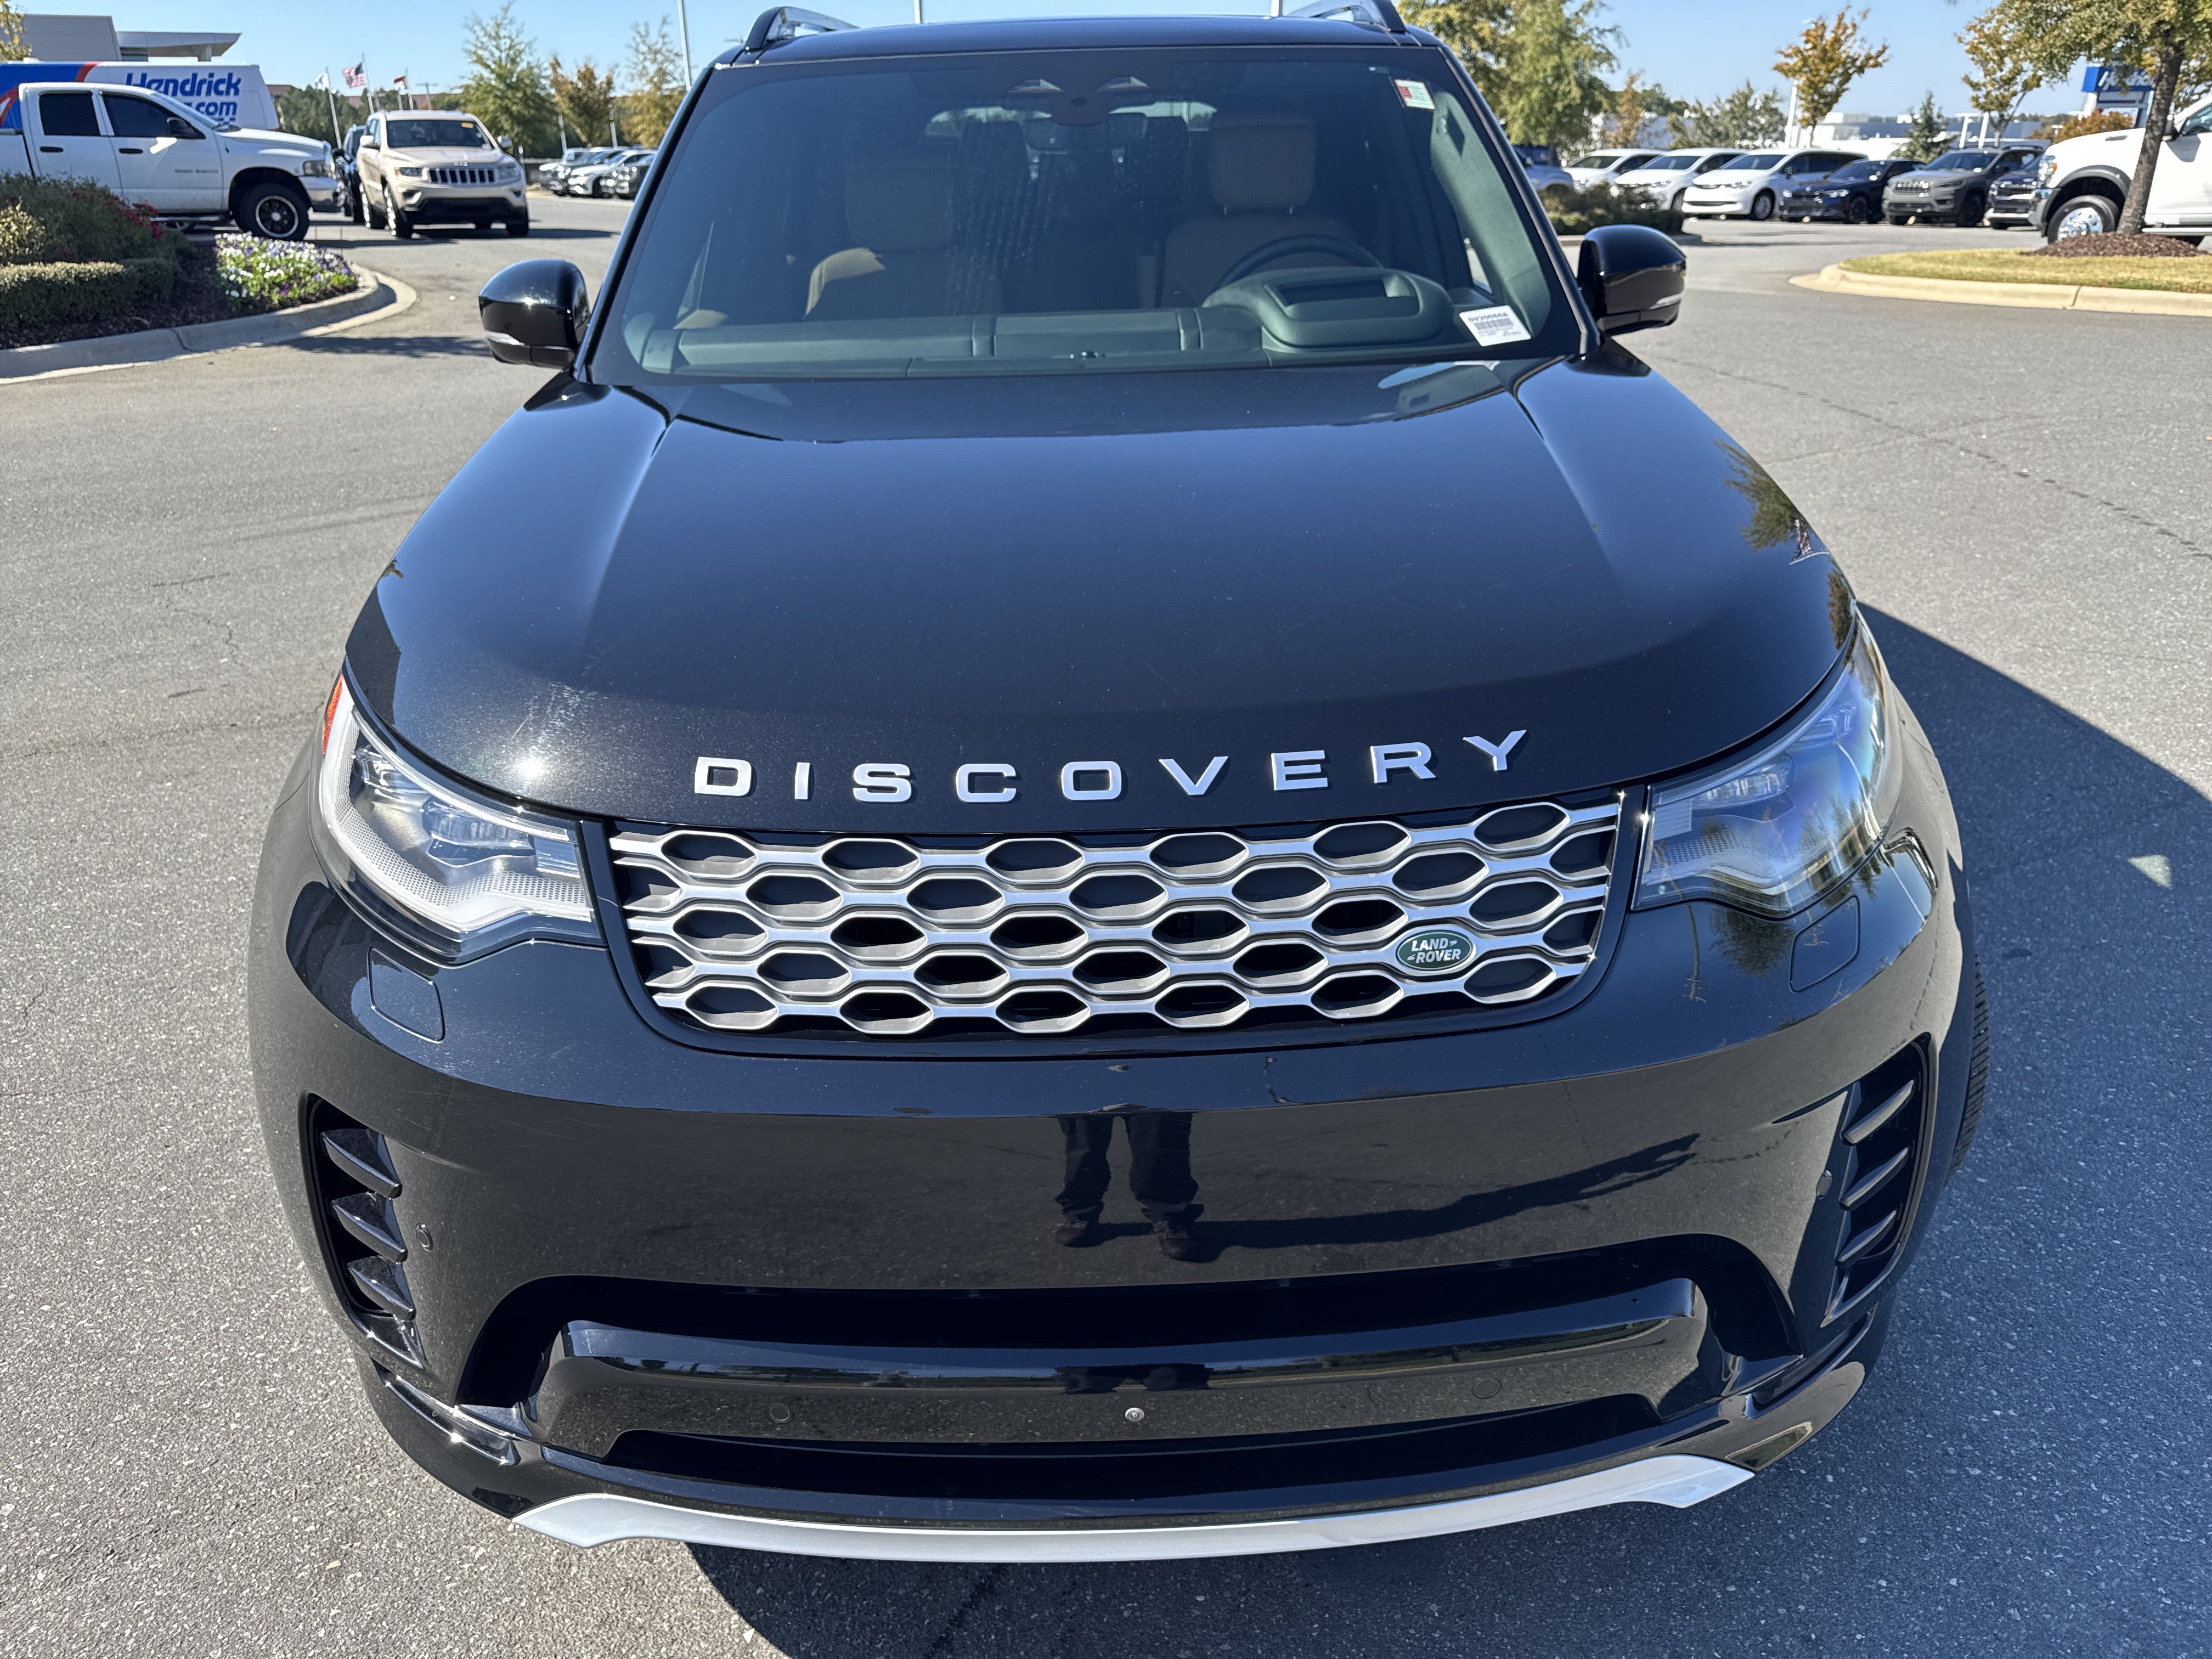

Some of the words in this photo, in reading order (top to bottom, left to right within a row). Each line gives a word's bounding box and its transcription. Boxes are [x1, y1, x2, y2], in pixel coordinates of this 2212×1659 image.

[694, 729, 1527, 803] DISCOVERY
[1410, 937, 1449, 952] LAND
[1415, 948, 1462, 963] ROVER
